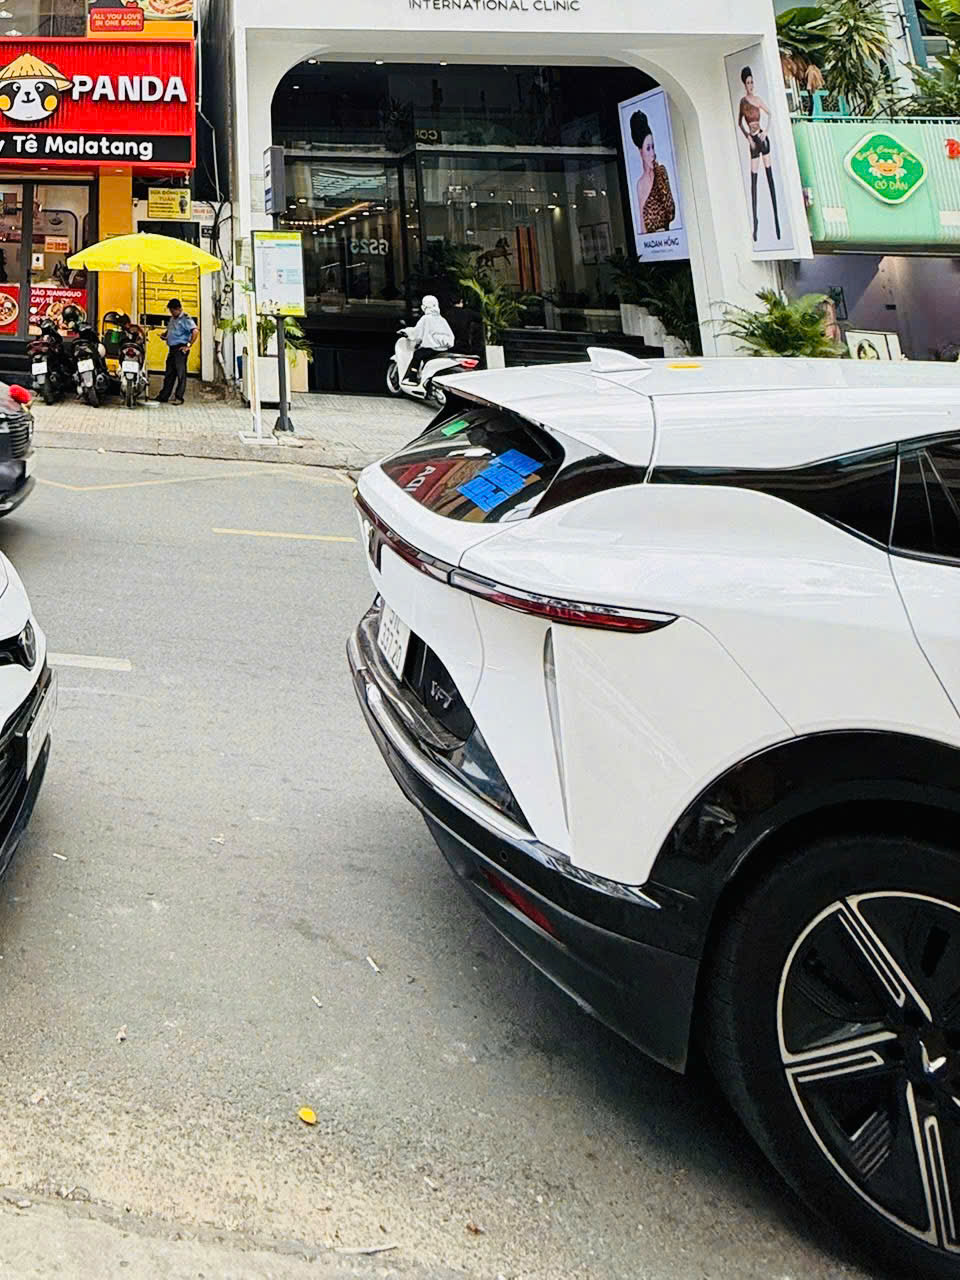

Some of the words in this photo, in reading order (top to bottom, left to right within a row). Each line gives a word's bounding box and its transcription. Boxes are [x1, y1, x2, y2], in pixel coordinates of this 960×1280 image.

[532, 0, 581, 12] CLINIC
[71, 74, 188, 102] PANDA
[12, 134, 39, 154] Tê
[45, 135, 153, 160] Malatang
[161, 272, 175, 283] 44
